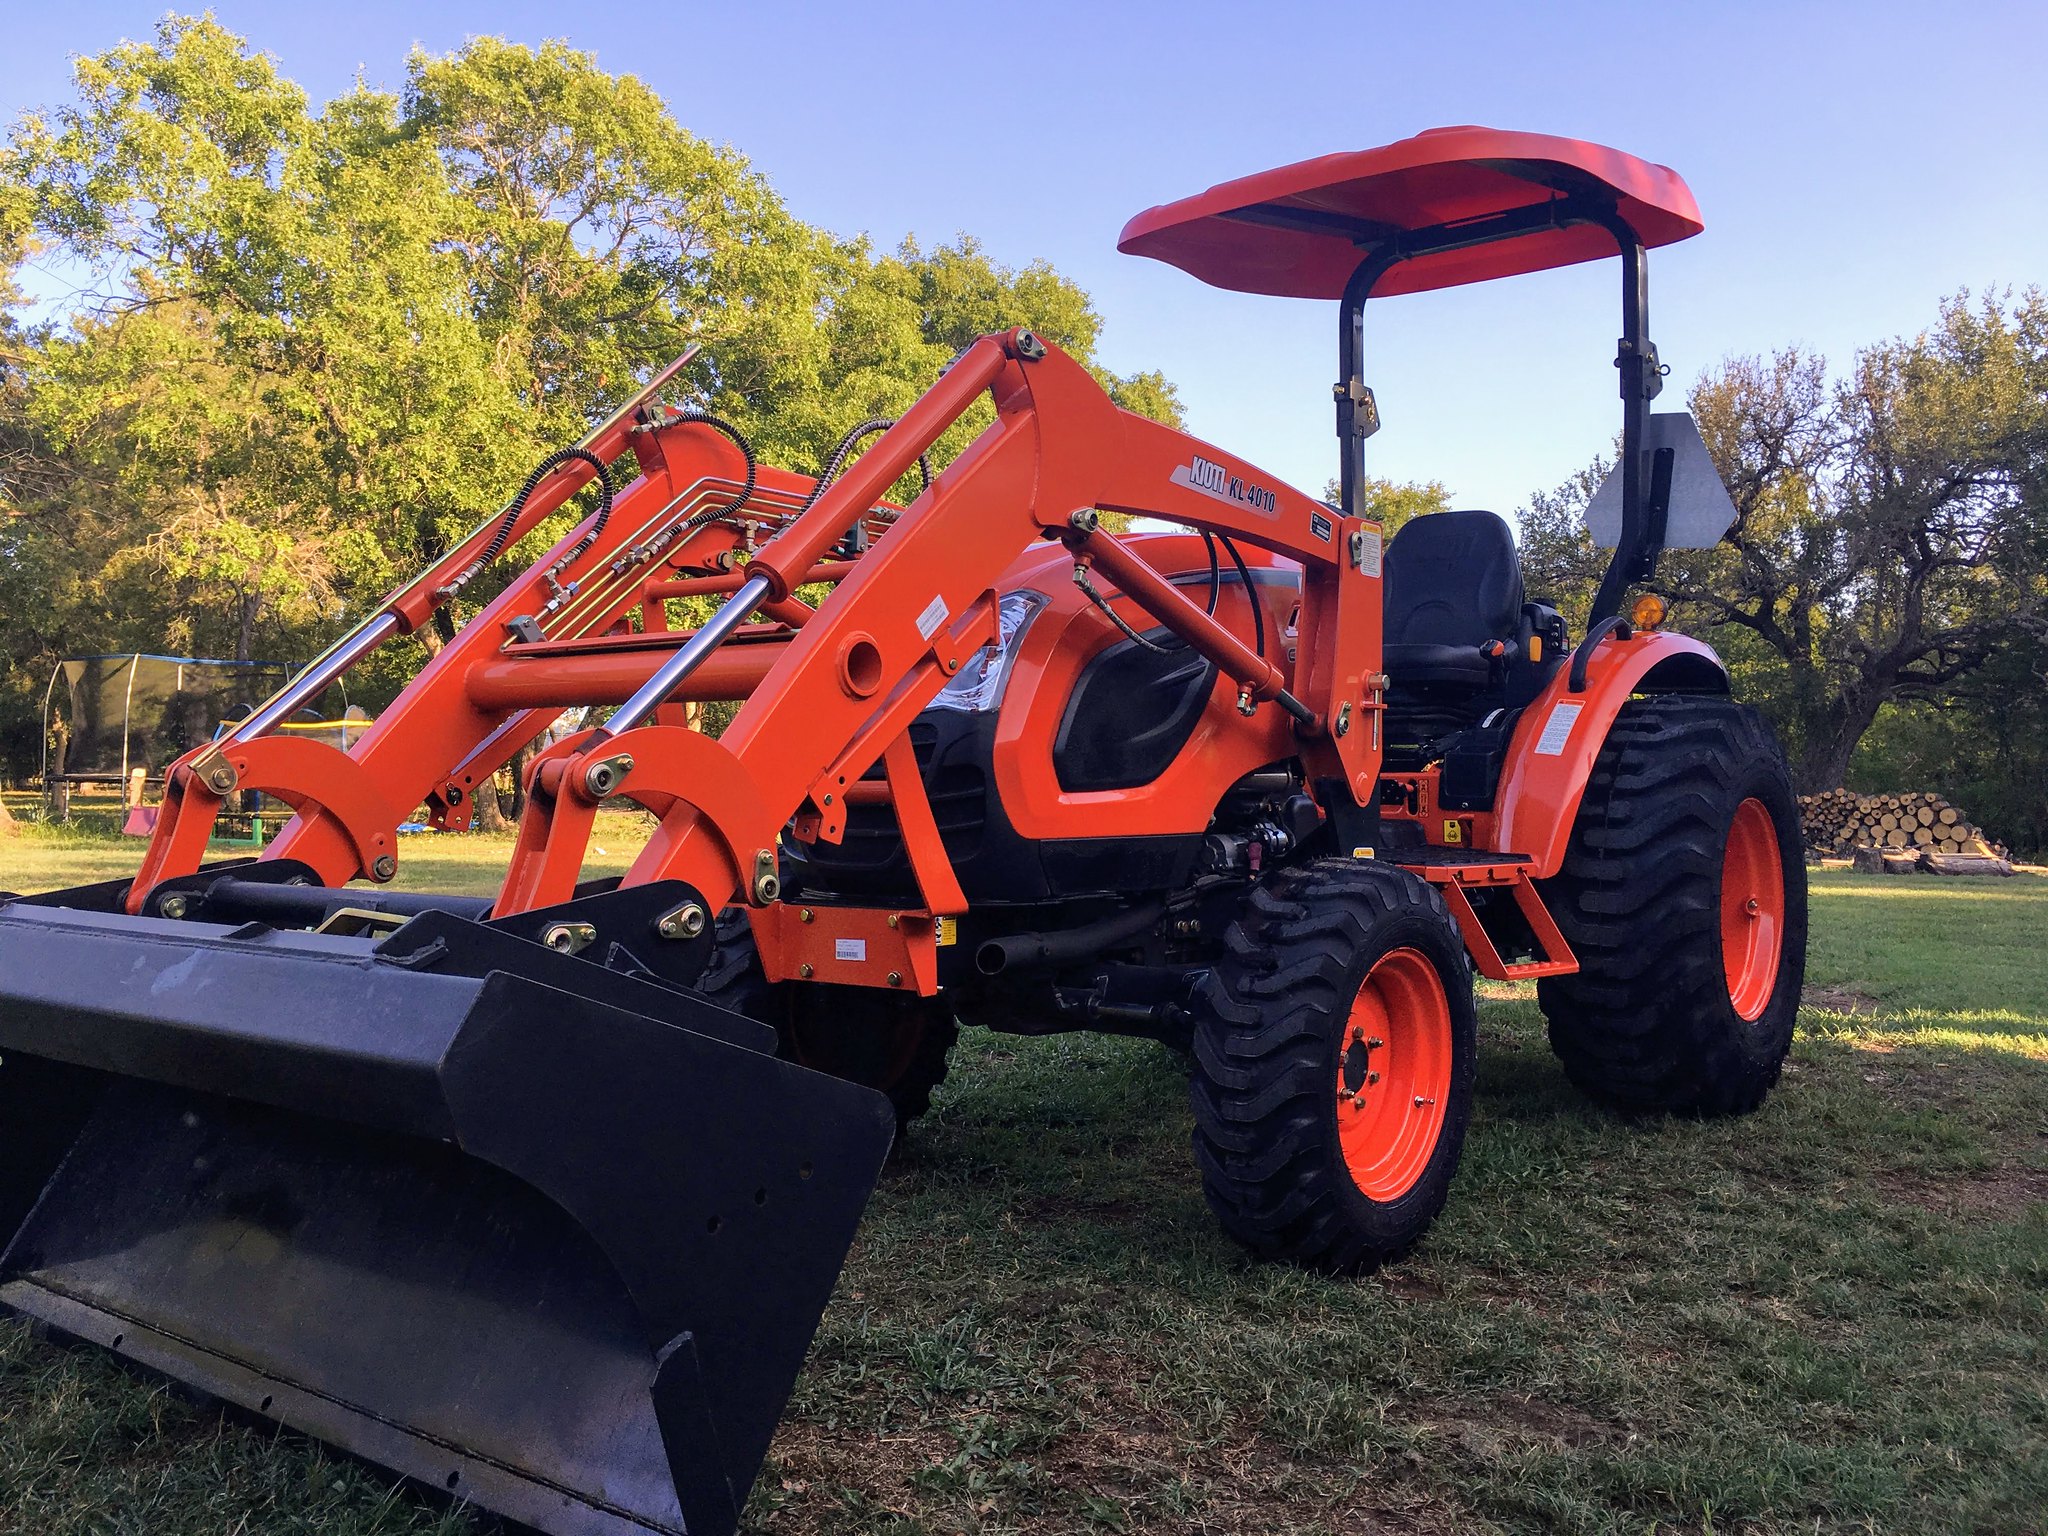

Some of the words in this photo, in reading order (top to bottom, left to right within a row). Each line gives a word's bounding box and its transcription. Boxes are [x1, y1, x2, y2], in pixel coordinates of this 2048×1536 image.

[1190, 455, 1226, 494] KIOTI
[1229, 476, 1244, 501] KL
[1247, 485, 1276, 512] 4010
